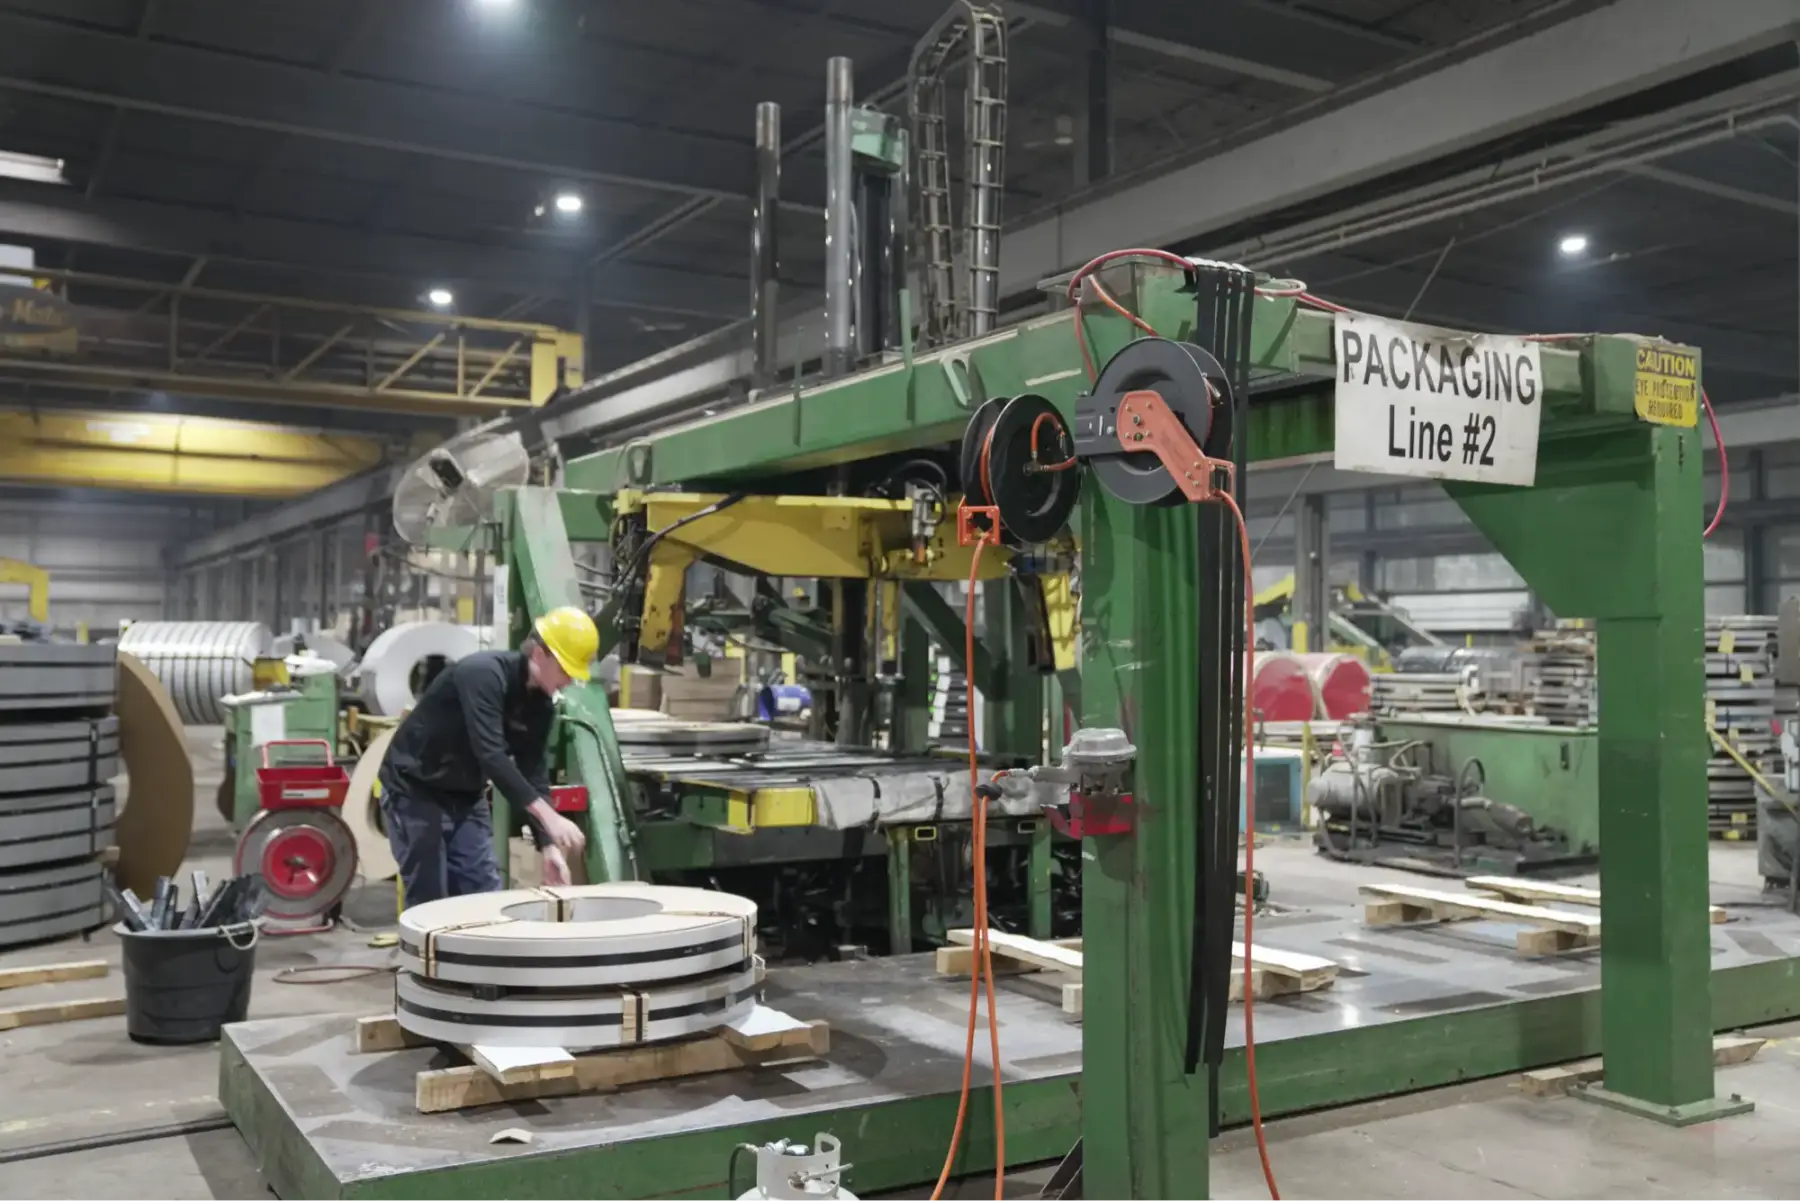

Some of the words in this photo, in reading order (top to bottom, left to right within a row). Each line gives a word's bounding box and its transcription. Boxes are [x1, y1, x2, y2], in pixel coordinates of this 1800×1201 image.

[1343, 330, 1535, 405] PACKAGING
[1636, 349, 1695, 377] CAUTION
[1388, 404, 1453, 461] Line
[1463, 412, 1496, 466] #2
